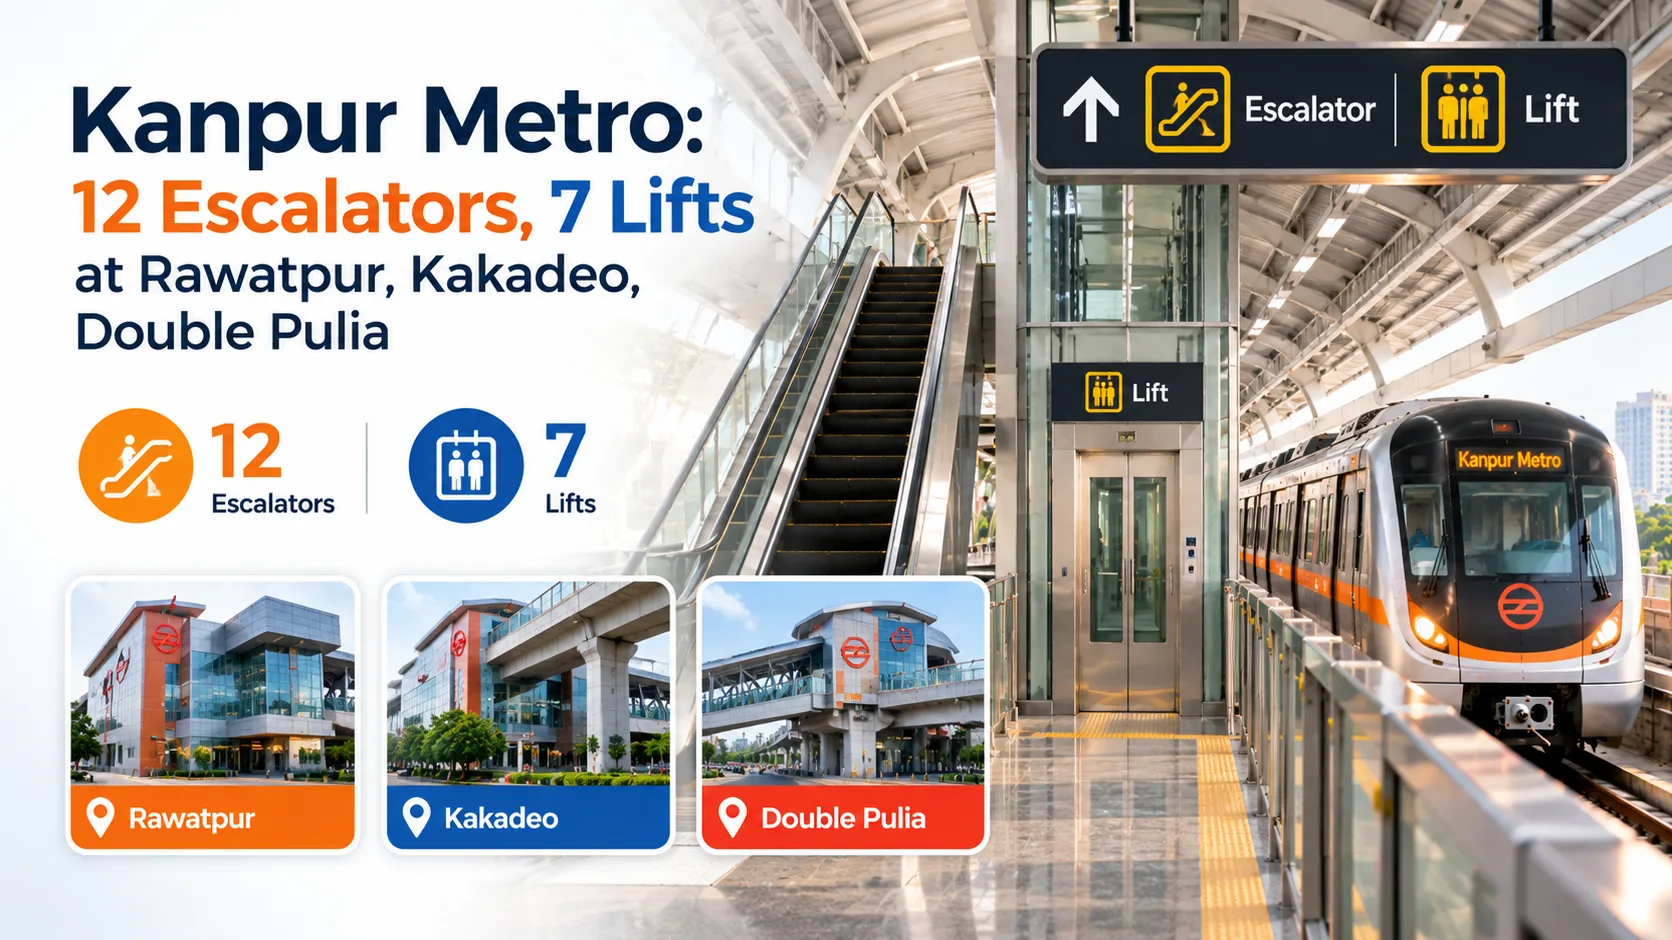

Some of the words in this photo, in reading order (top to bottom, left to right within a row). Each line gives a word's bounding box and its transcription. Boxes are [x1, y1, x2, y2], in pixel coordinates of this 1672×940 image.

[1246, 95, 1376, 122] Escalator
[1526, 94, 1579, 122] Lift
[1133, 383, 1168, 402] Lift
[1458, 451, 1514, 471] Kanpur
[1517, 451, 1562, 468] Metro
